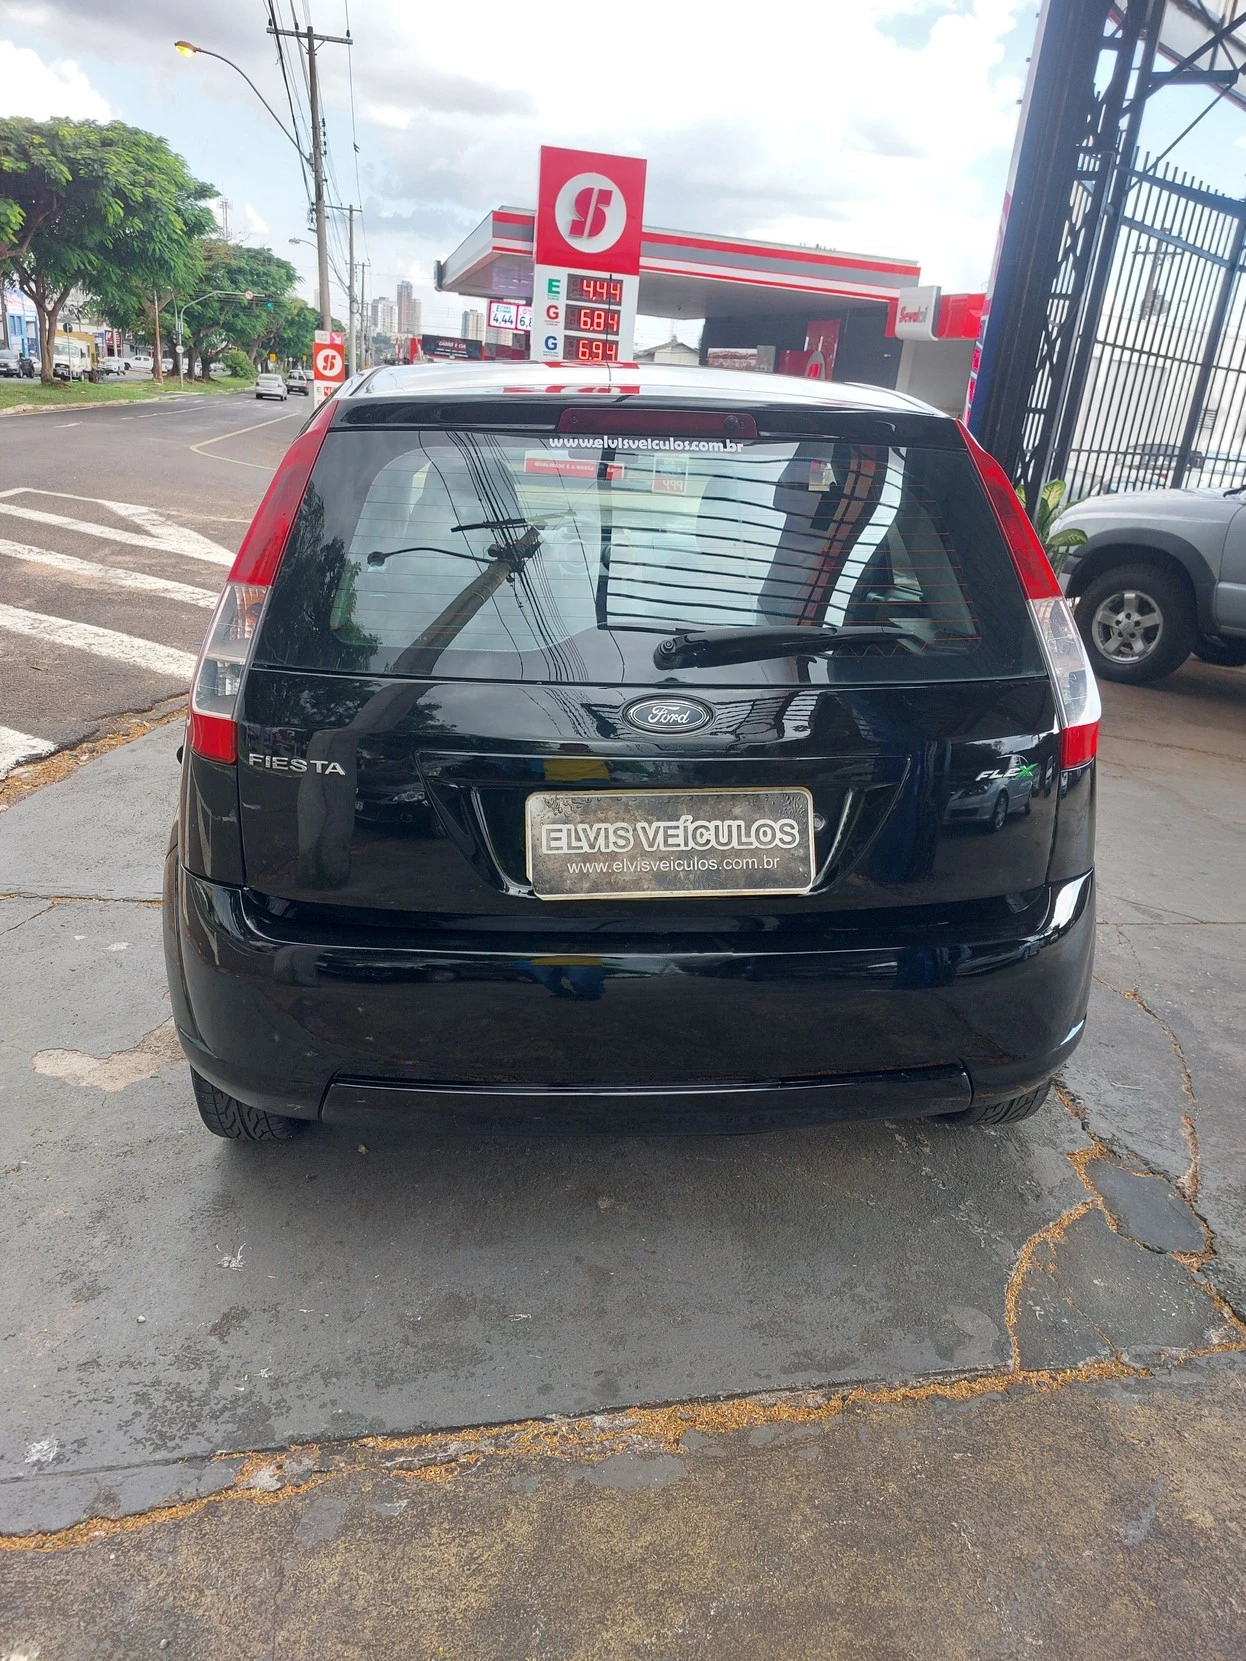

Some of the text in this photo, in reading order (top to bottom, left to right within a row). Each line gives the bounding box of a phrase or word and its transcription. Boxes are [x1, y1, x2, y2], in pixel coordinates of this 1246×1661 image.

[547, 278, 621, 302] E 4,44
[493, 313, 514, 326] 4,44
[519, 316, 532, 328] 6,8
[545, 304, 618, 332] G 6,84
[544, 335, 558, 351] G
[549, 435, 744, 453] www.elvisveiculos.com.br
[648, 706, 690, 724] Ford
[248, 753, 346, 776] FIESTA
[975, 762, 1039, 782] FLEX
[541, 814, 800, 855] ELVIS VEÍCULOS
[567, 856, 780, 874] www.elvisveiculos.com.br
